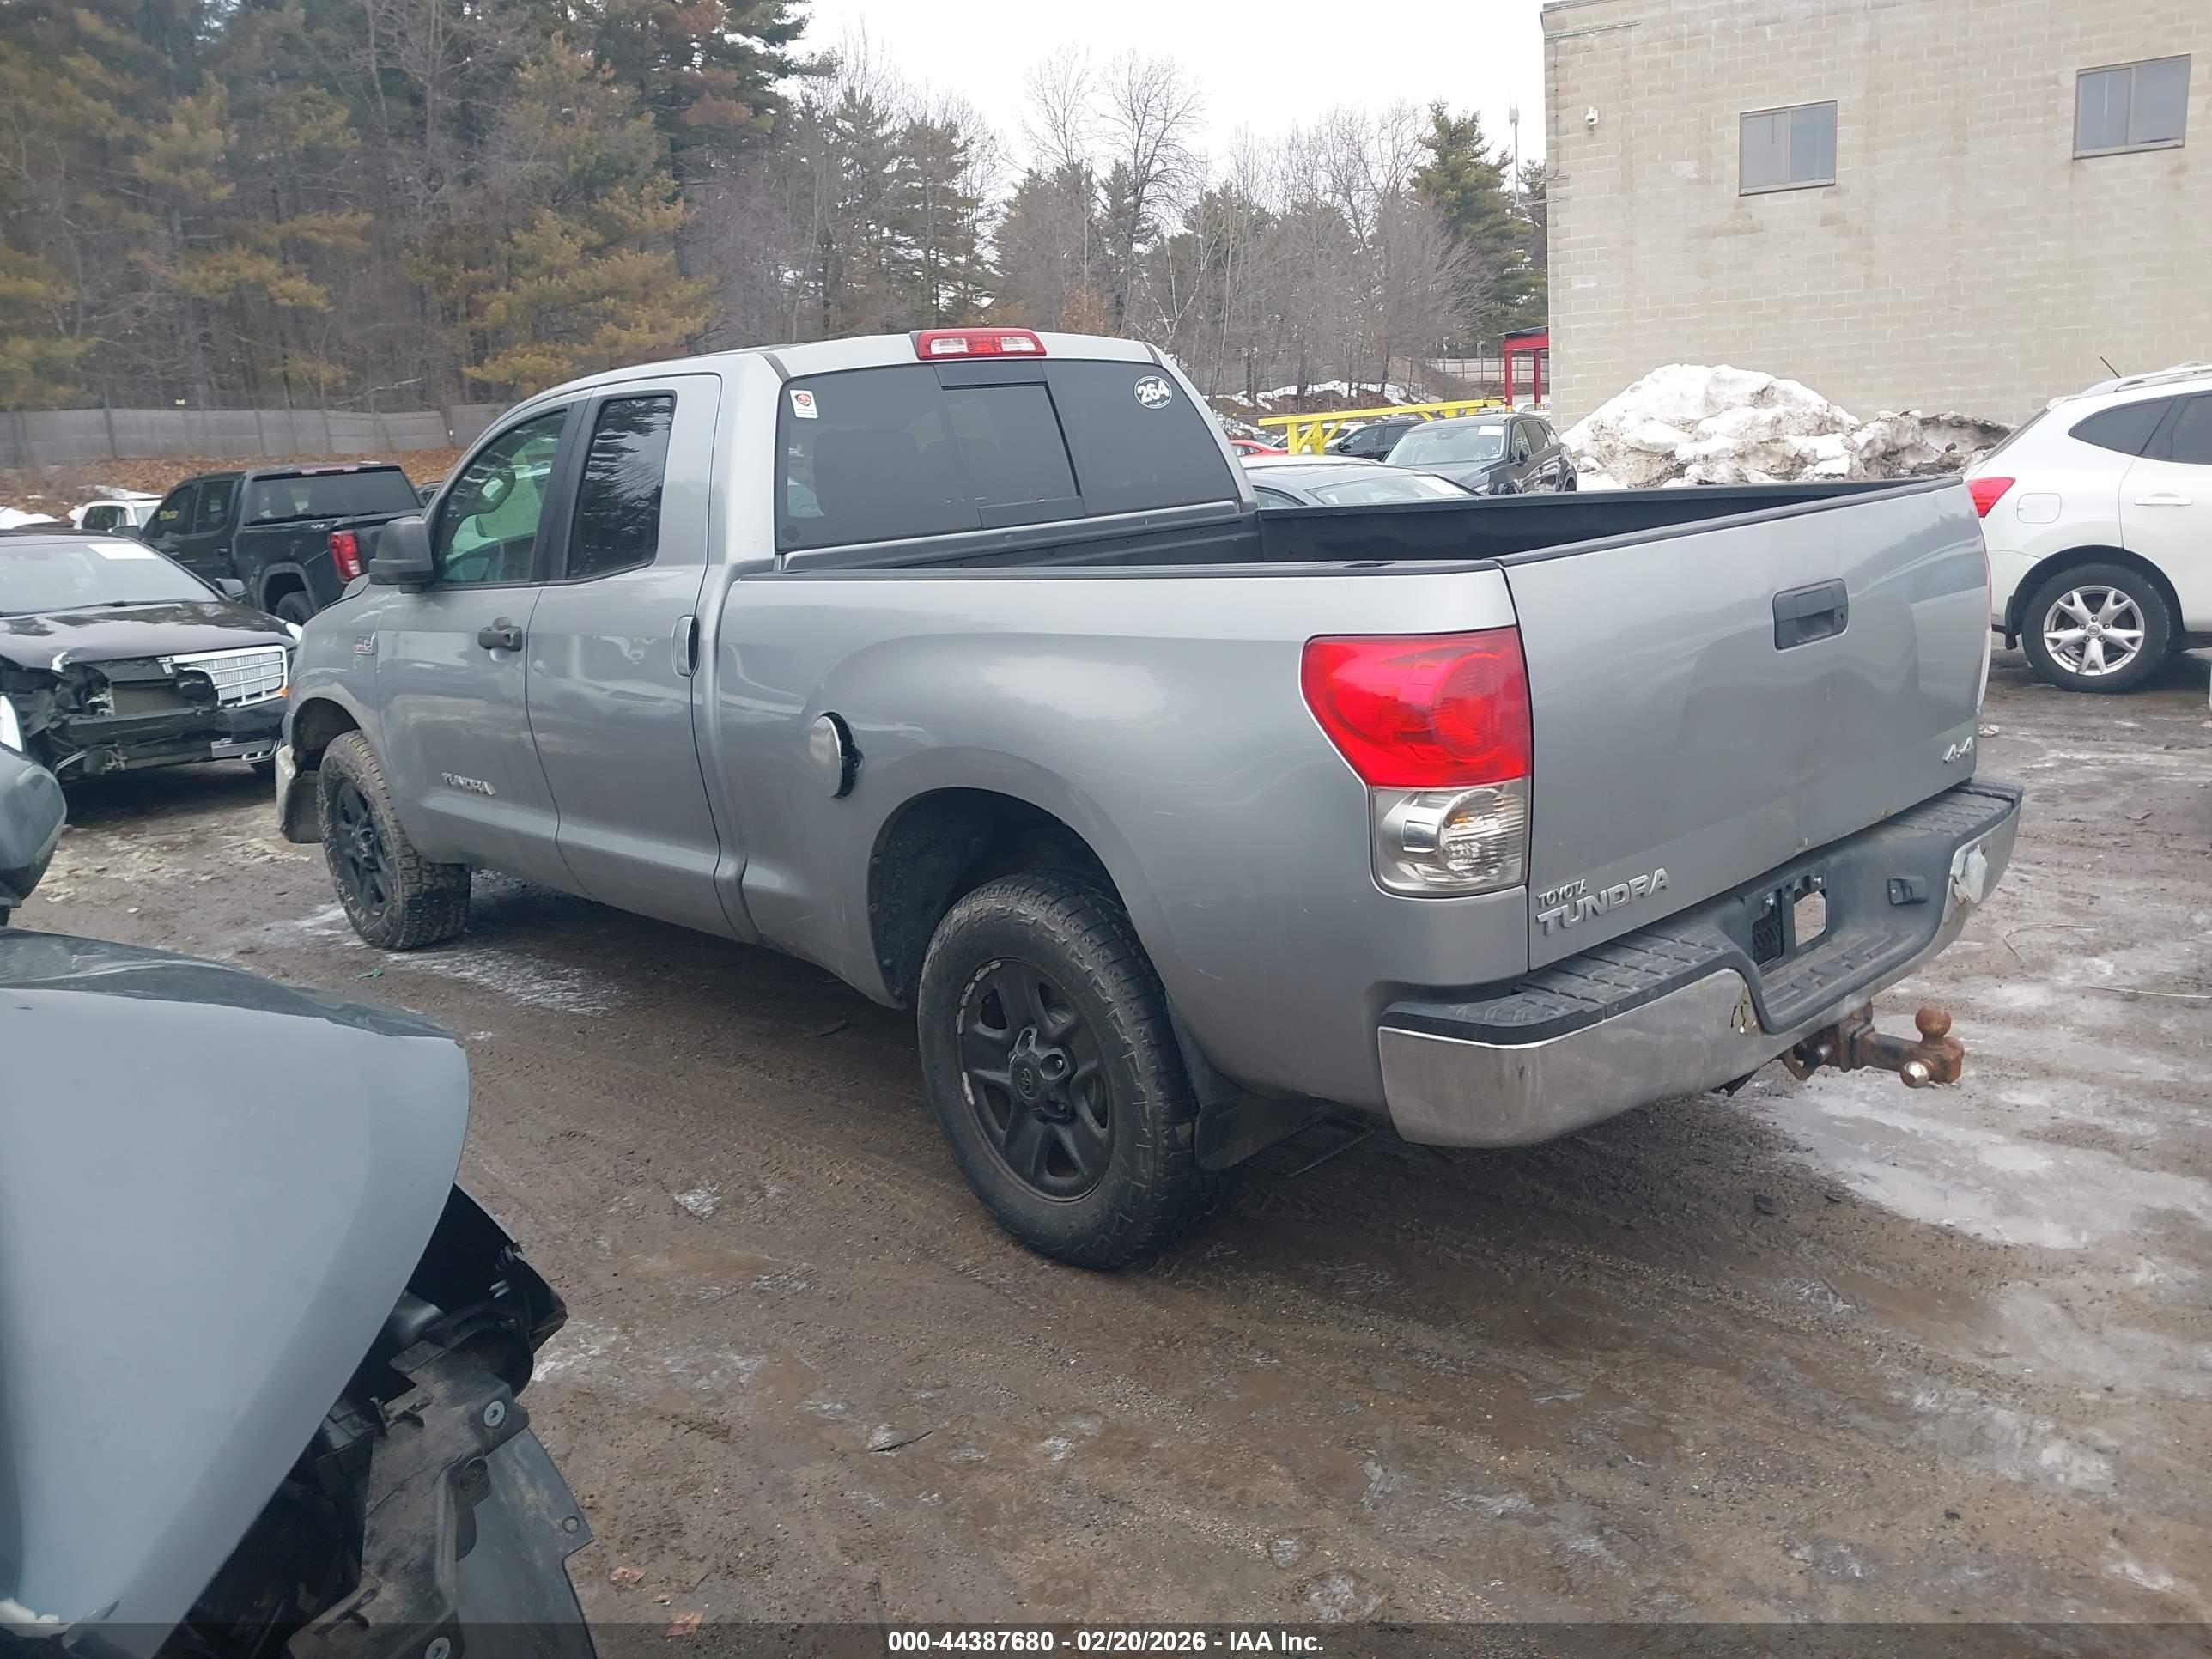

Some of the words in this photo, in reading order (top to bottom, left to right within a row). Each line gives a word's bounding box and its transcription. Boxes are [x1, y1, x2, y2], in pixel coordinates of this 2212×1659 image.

[1137, 380, 1170, 404] 264
[1536, 867, 1670, 936] TUNDRA
[1537, 878, 1587, 908] TOYOTA
